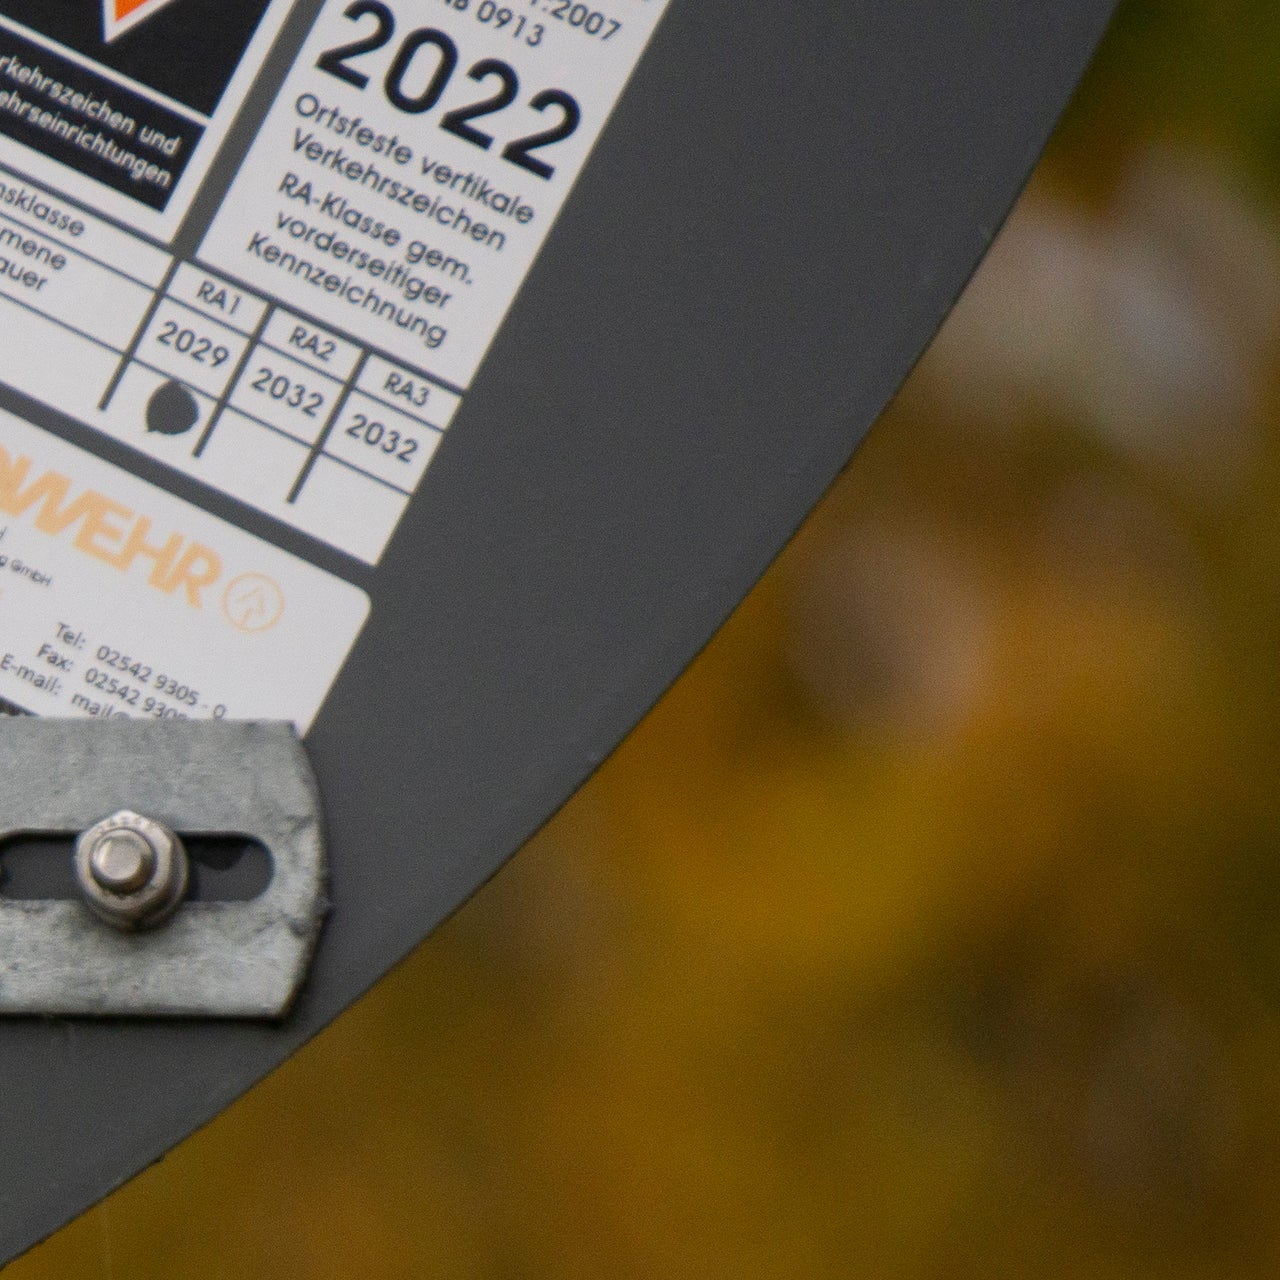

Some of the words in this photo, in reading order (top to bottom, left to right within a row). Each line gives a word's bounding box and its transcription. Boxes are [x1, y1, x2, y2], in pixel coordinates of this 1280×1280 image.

[476, 0, 544, 46] 0913
[314, 0, 581, 181] 2022
[139, 125, 182, 157] und
[295, 93, 413, 165] Ortsfeste
[421, 154, 534, 224] vertikale
[293, 128, 506, 251] Verkehrszeichen
[278, 172, 400, 247] RA-Klasse
[408, 238, 473, 285] gem.
[277, 211, 452, 309] vorderseitiger
[196, 280, 241, 315] RA1
[246, 231, 447, 348] Kennzeichnung
[156, 319, 230, 367] 2029
[289, 326, 337, 362] RA2
[251, 367, 324, 418] 2032
[383, 372, 431, 407] RA3
[345, 413, 419, 464] 2032
[10, 558, 53, 587] GmbH
[0, 652, 63, 696] E-mail:
[37, 642, 74, 673] Fax:
[84, 667, 142, 706] 02542
[56, 621, 86, 650] Tel:
[95, 645, 153, 683] 02542
[154, 674, 200, 707] 9305
